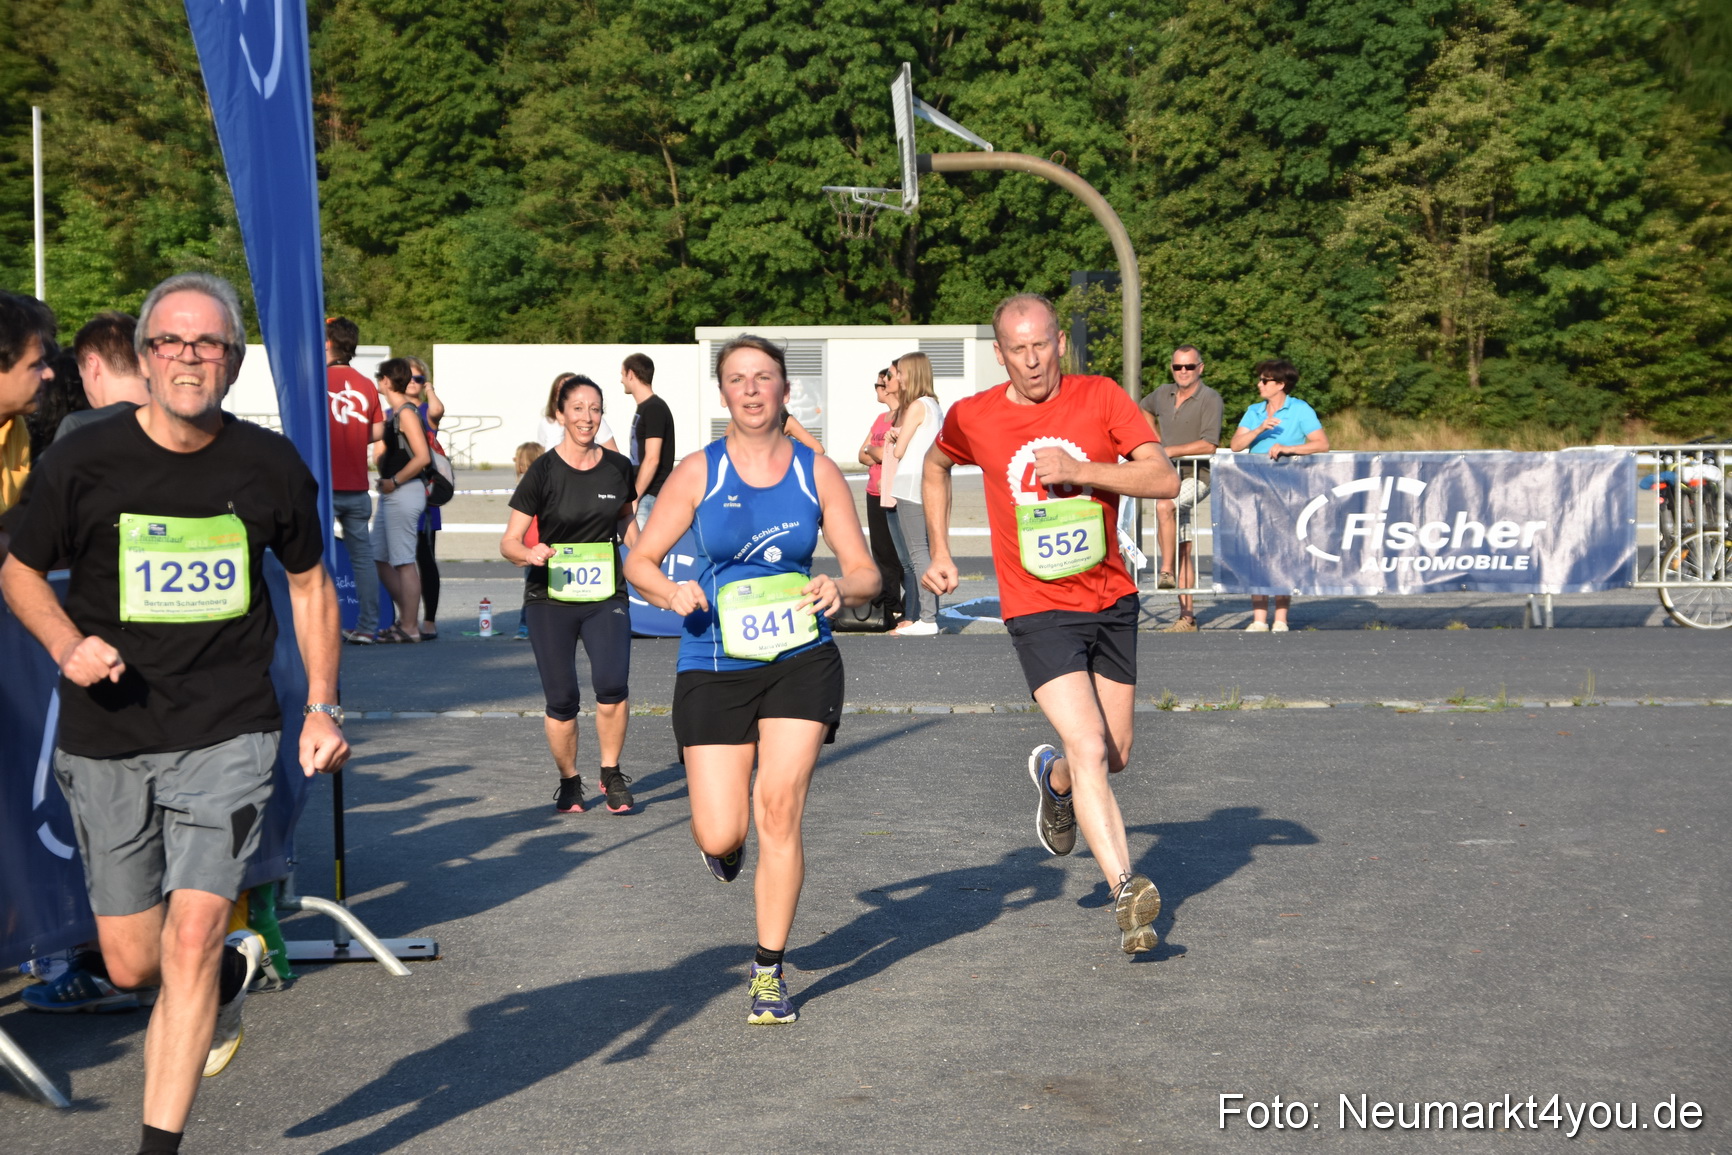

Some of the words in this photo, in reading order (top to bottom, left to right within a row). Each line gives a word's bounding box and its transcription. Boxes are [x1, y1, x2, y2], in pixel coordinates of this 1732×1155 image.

[733, 541, 753, 561] Team
[751, 524, 781, 543] Schick
[781, 520, 801, 531] Bau
[1038, 528, 1089, 559] 552
[1340, 511, 1547, 550] Fischer
[135, 558, 236, 593] 1239
[562, 566, 602, 586] 102
[1360, 555, 1531, 573] AUTOMOBILE
[143, 599, 175, 607] Bertram
[176, 598, 228, 607] Scharfenberg
[741, 607, 795, 641] 841
